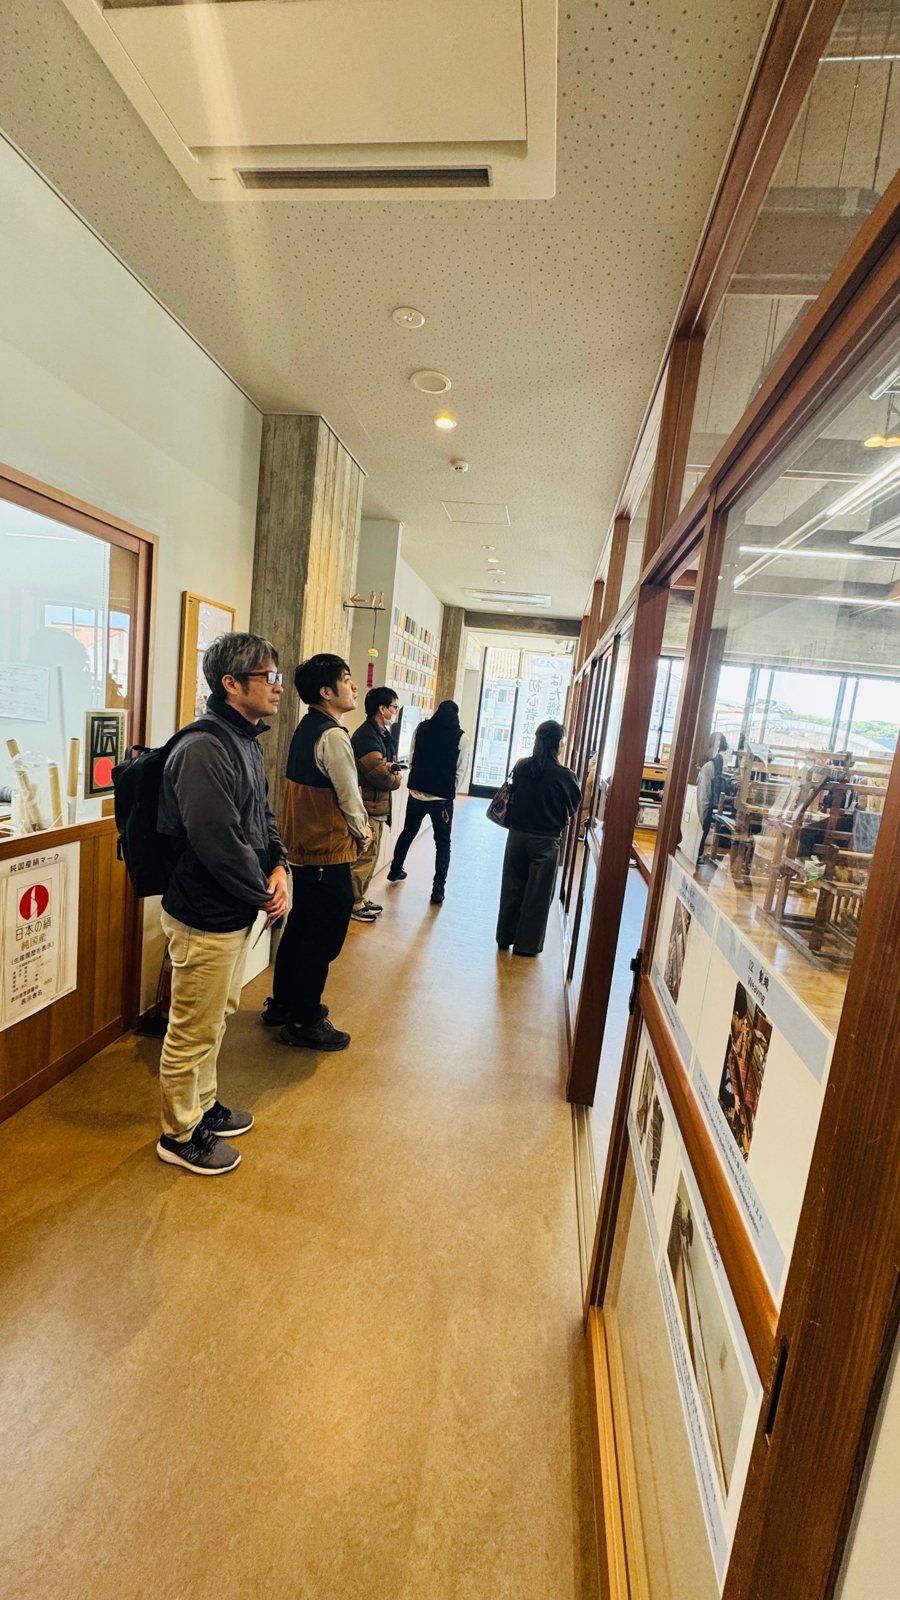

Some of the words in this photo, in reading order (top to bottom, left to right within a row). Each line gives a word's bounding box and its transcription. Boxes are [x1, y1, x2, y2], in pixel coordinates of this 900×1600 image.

[10, 853, 60, 873] 純国産絹マーク
[16, 917, 52, 941] 日本の絹
